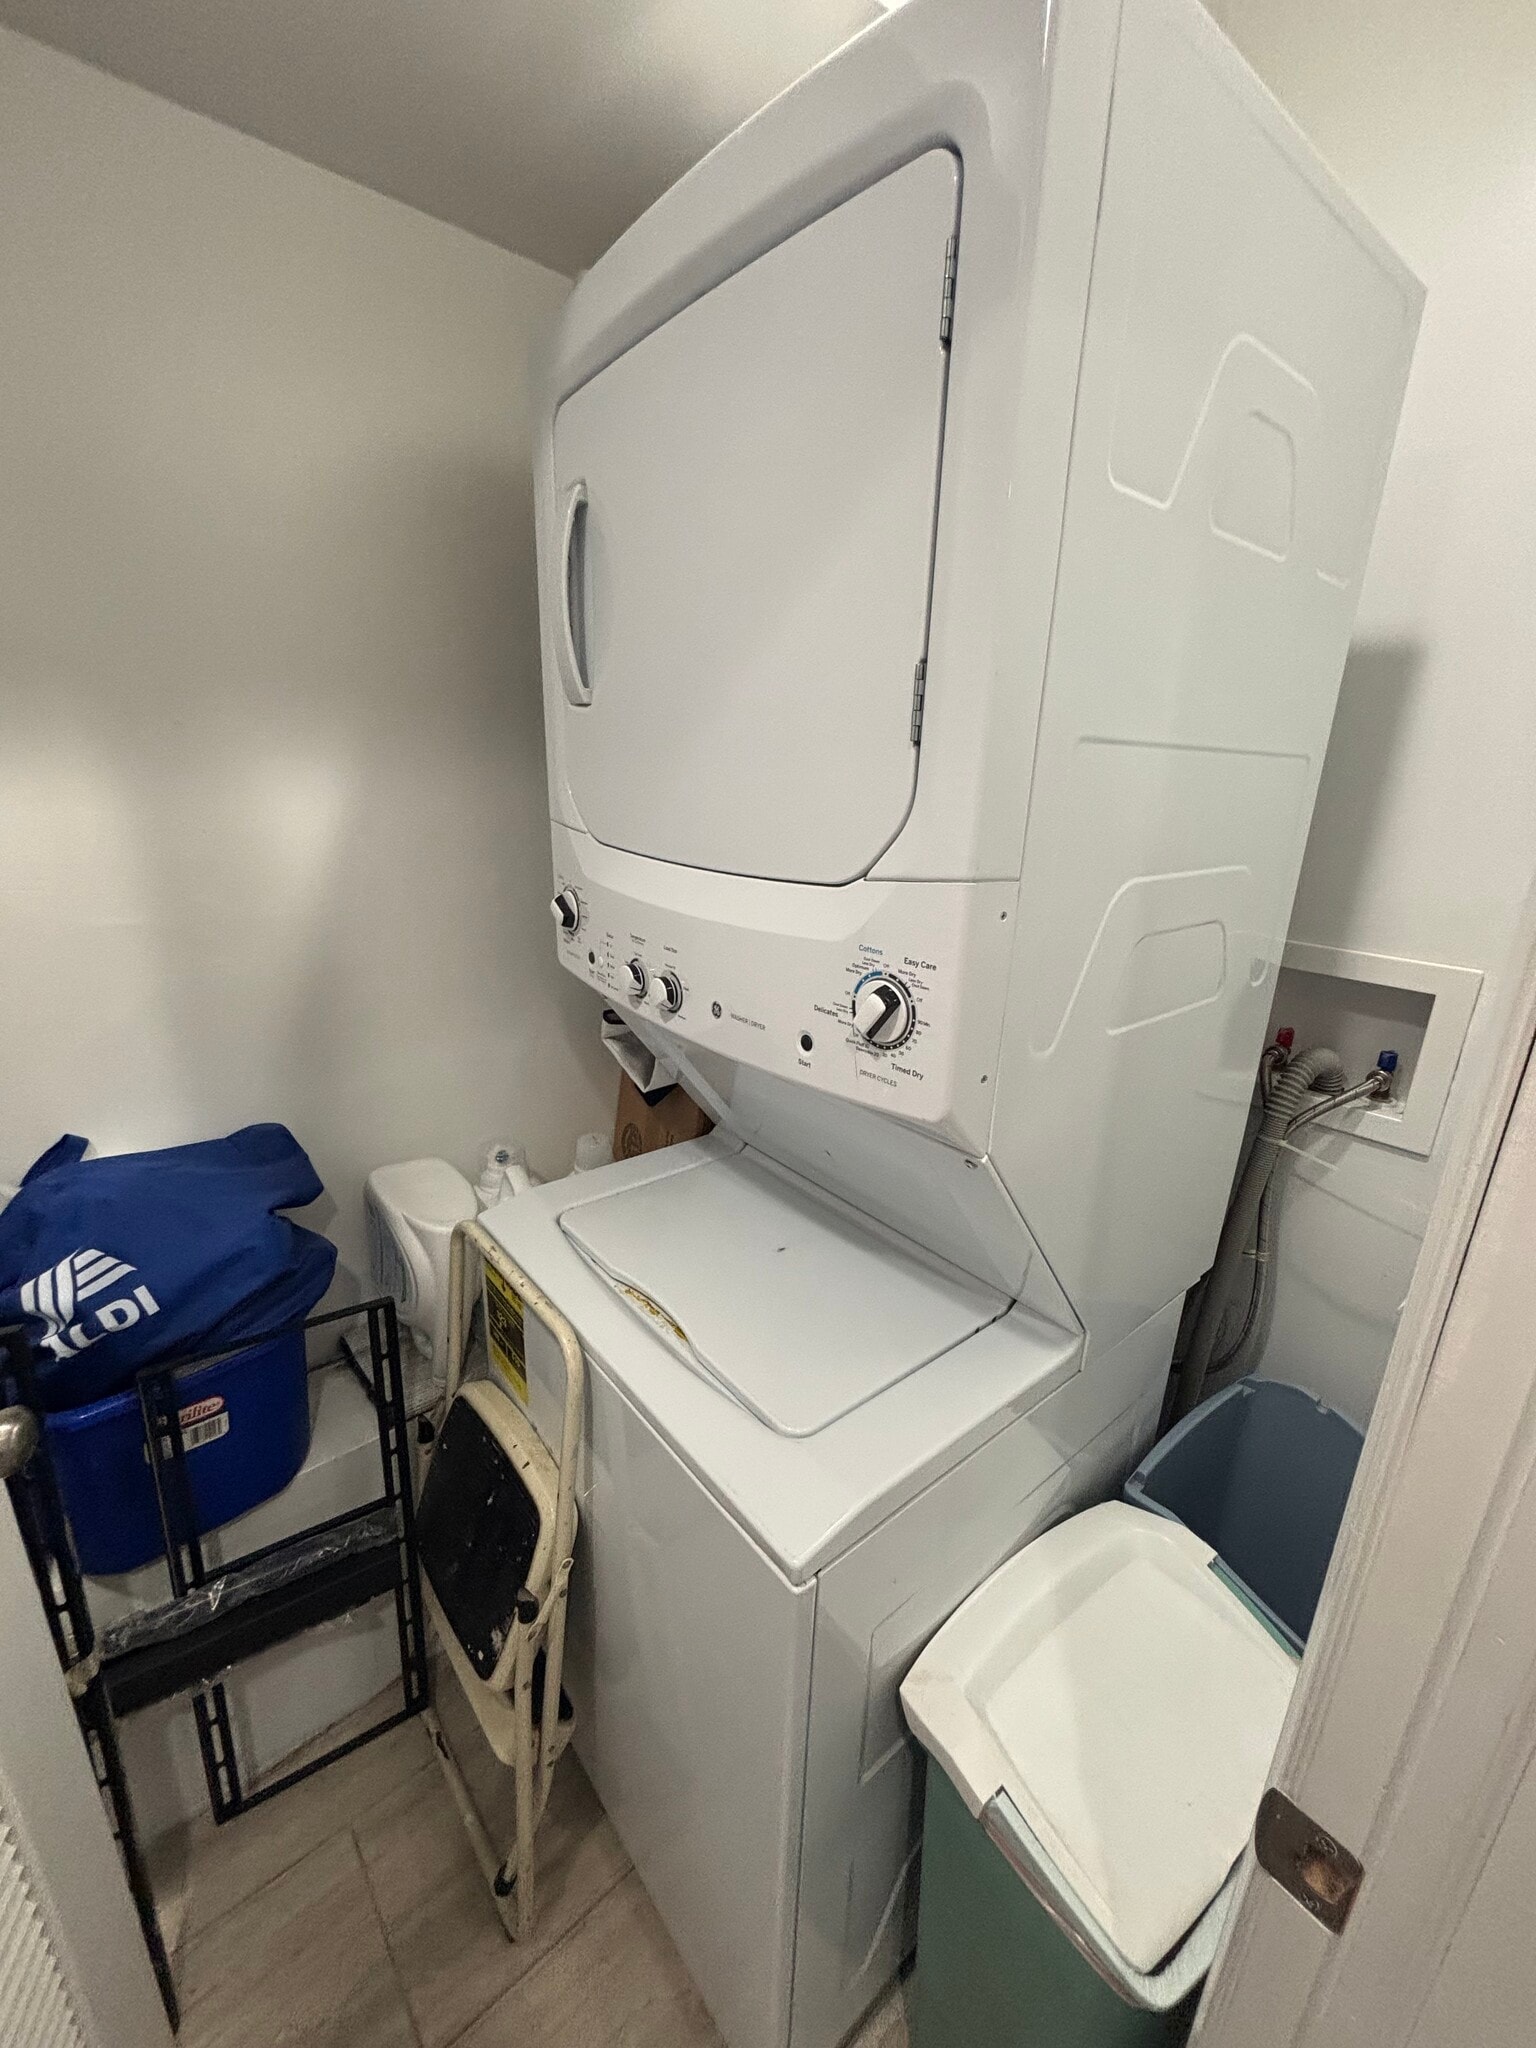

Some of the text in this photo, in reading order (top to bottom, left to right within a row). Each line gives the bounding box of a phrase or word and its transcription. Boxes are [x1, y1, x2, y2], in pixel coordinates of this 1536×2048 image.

[858, 944, 883, 956] Cottons
[904, 957, 937, 971] Easy Care
[814, 1004, 838, 1018] Delicates
[750, 1020, 766, 1030] DRYER
[798, 1058, 811, 1068] Start
[860, 1070, 898, 1088] DRYER CYCLES
[890, 1063, 924, 1081] Timed Dry
